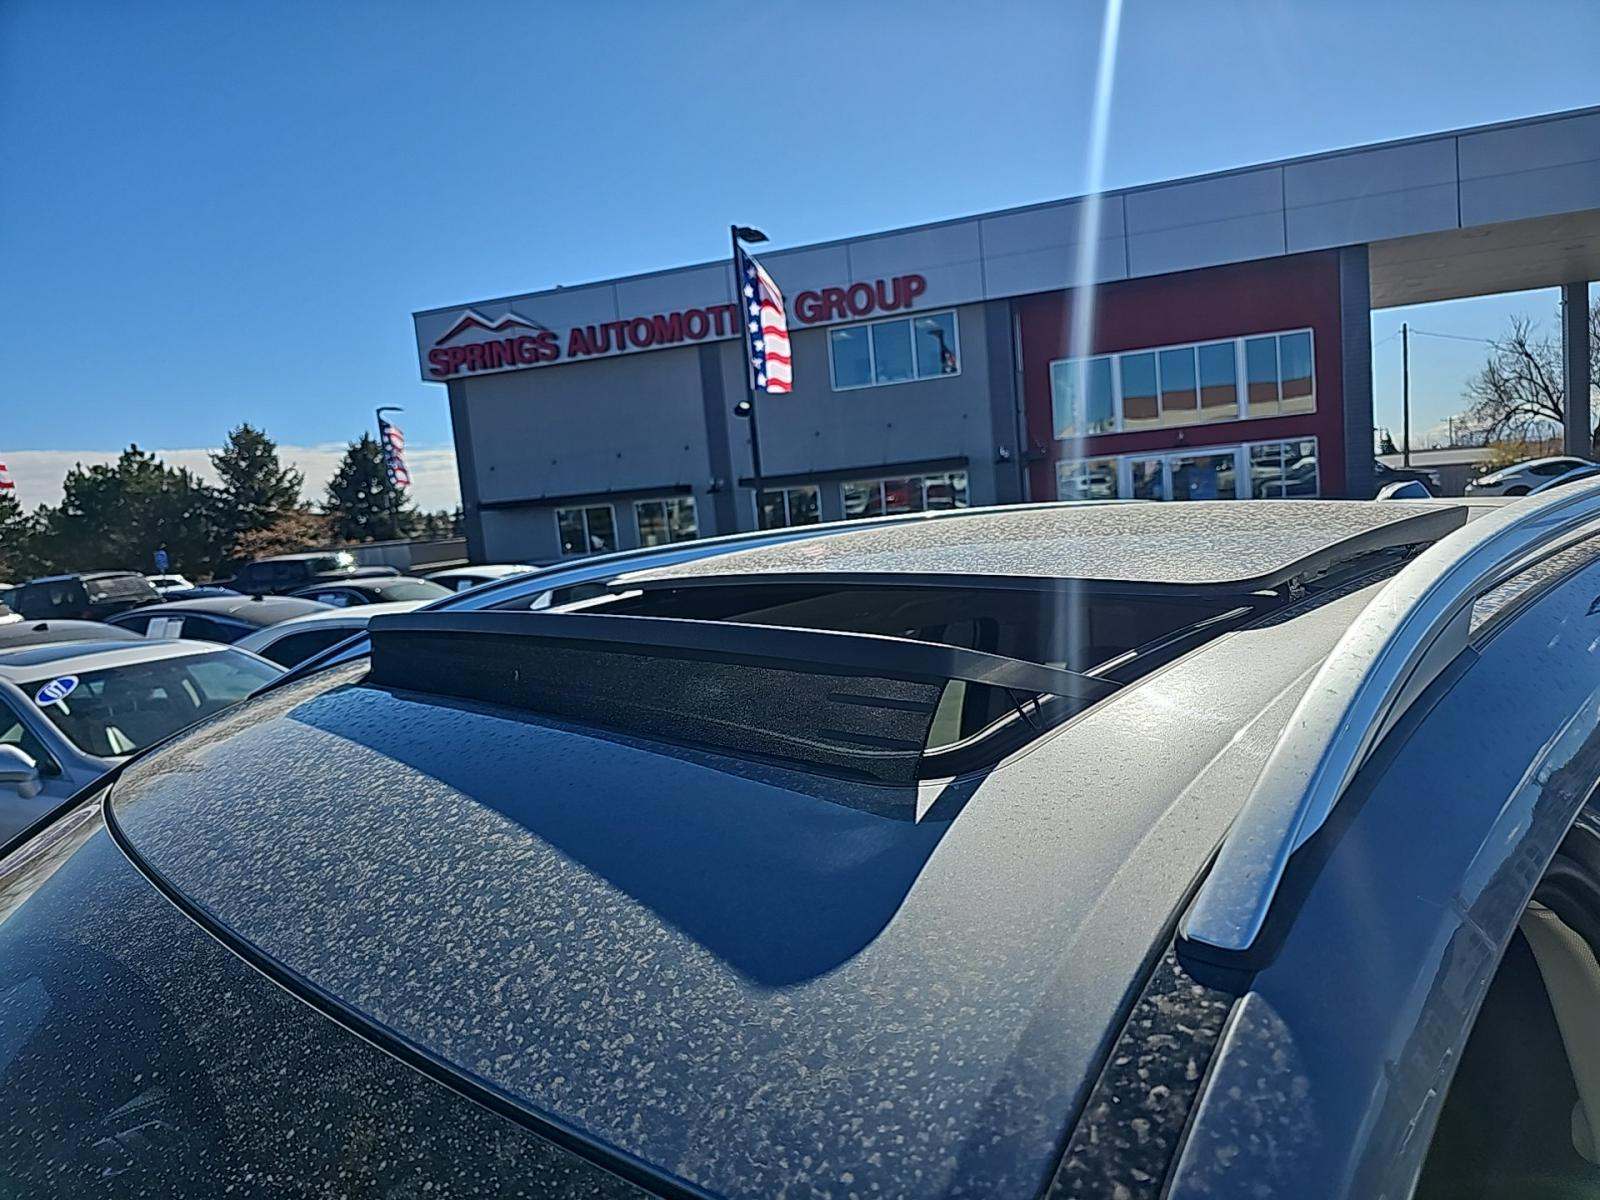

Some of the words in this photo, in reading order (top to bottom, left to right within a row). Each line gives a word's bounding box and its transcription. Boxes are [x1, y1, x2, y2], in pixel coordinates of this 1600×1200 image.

[428, 329, 561, 376] SPRINGS
[567, 298, 786, 358] AUTOMOTI
[794, 274, 926, 324] GROUP
